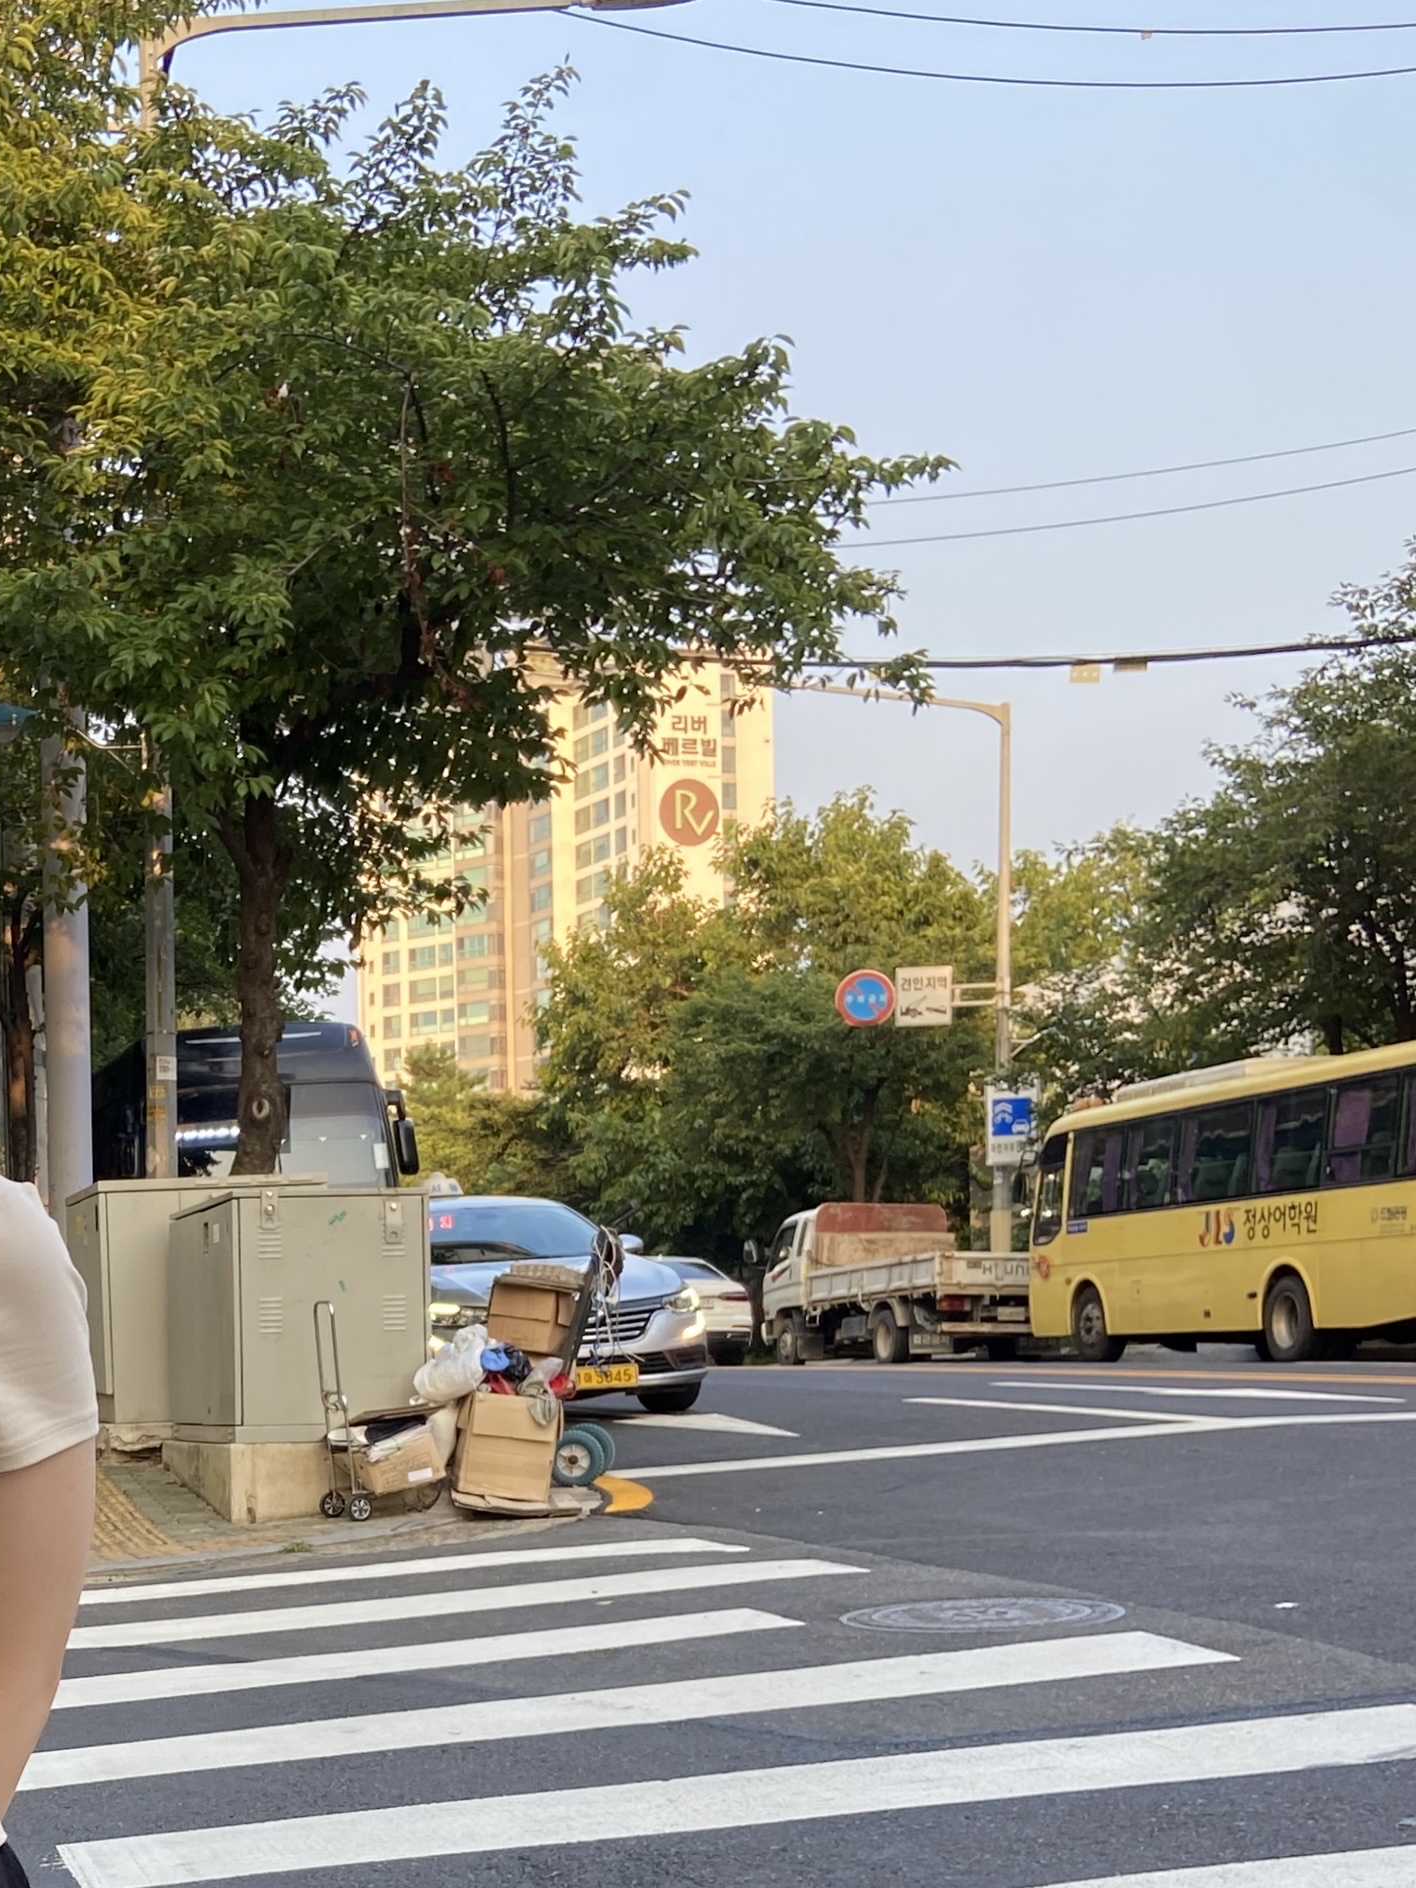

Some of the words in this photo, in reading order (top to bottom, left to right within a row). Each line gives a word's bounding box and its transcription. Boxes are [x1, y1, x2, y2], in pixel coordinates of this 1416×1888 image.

[671, 715, 707, 735] 리버
[662, 737, 717, 758] 베르빌
[900, 975, 948, 992] 견인지역
[1243, 1201, 1319, 1241] 정상어학원
